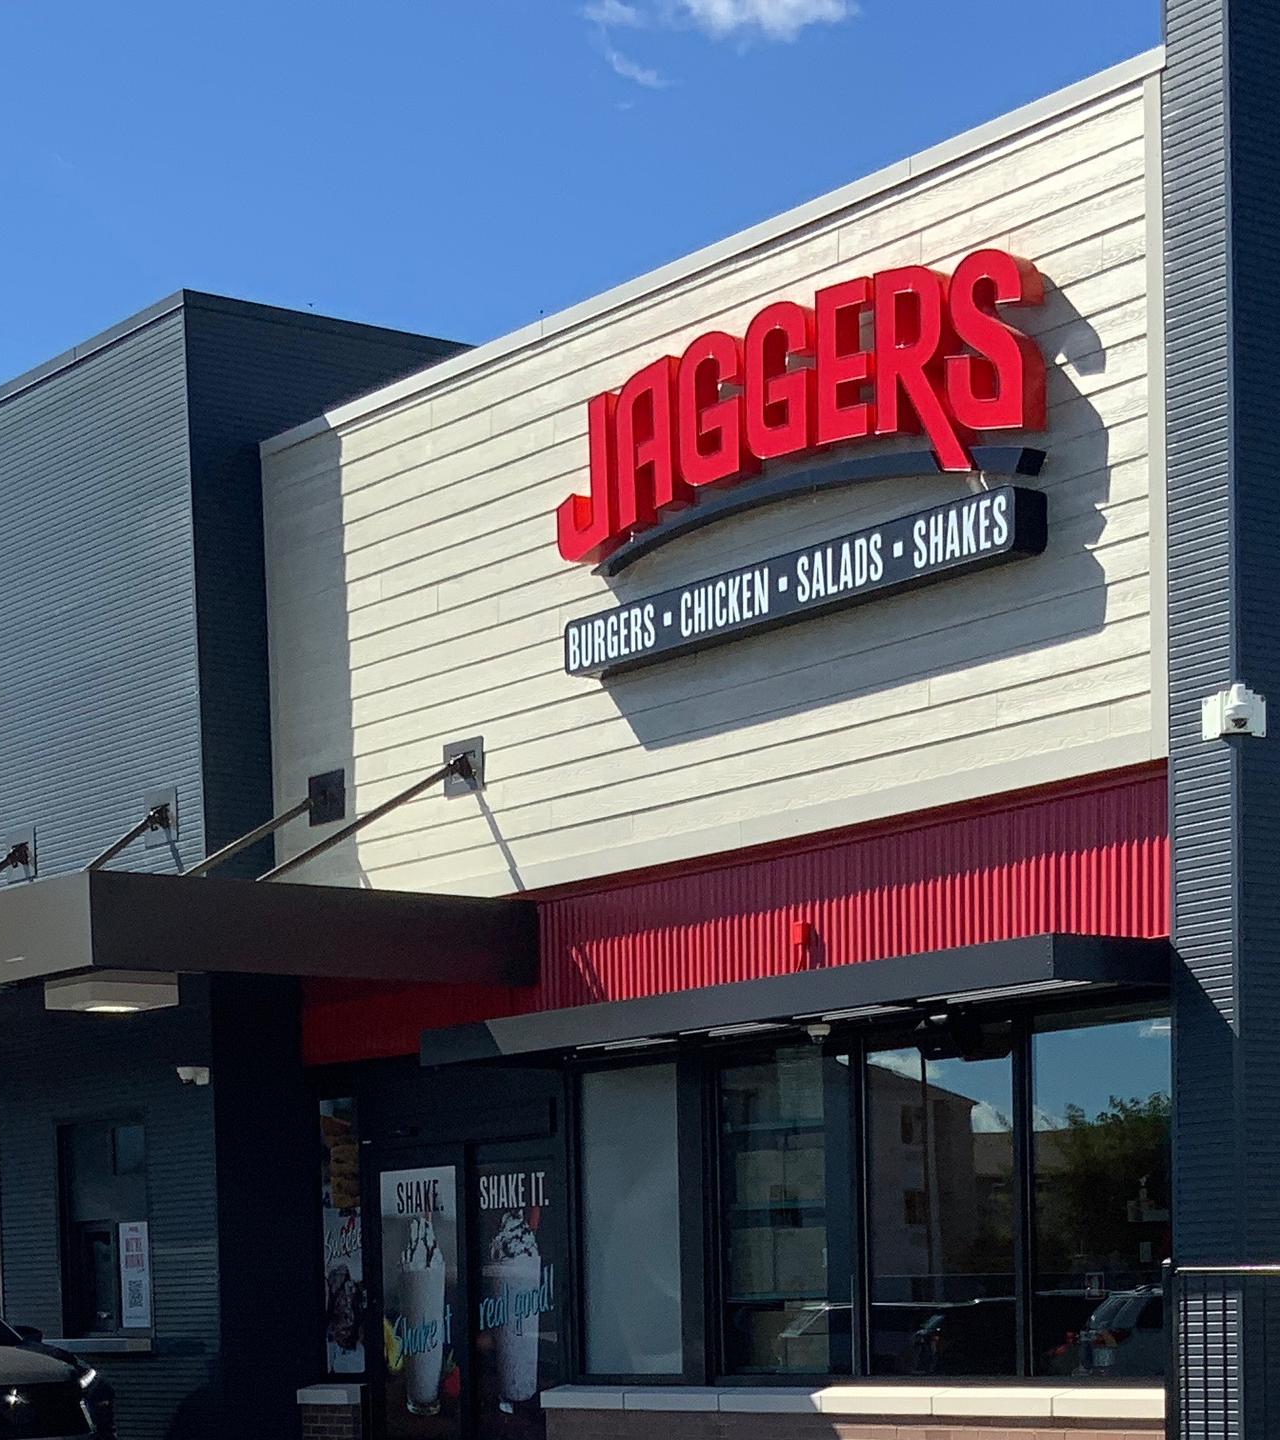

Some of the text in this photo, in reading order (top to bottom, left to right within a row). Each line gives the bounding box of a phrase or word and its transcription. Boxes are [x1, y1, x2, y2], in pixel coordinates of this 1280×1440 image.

[556, 248, 1047, 563] JAGGERS
[568, 495, 1009, 671] BURGERS CHICKEN SALADS SHAKES
[395, 1179, 445, 1214] SHAKE.
[479, 1171, 550, 1210] SHAKE IT.
[479, 1263, 556, 1337] real good!
